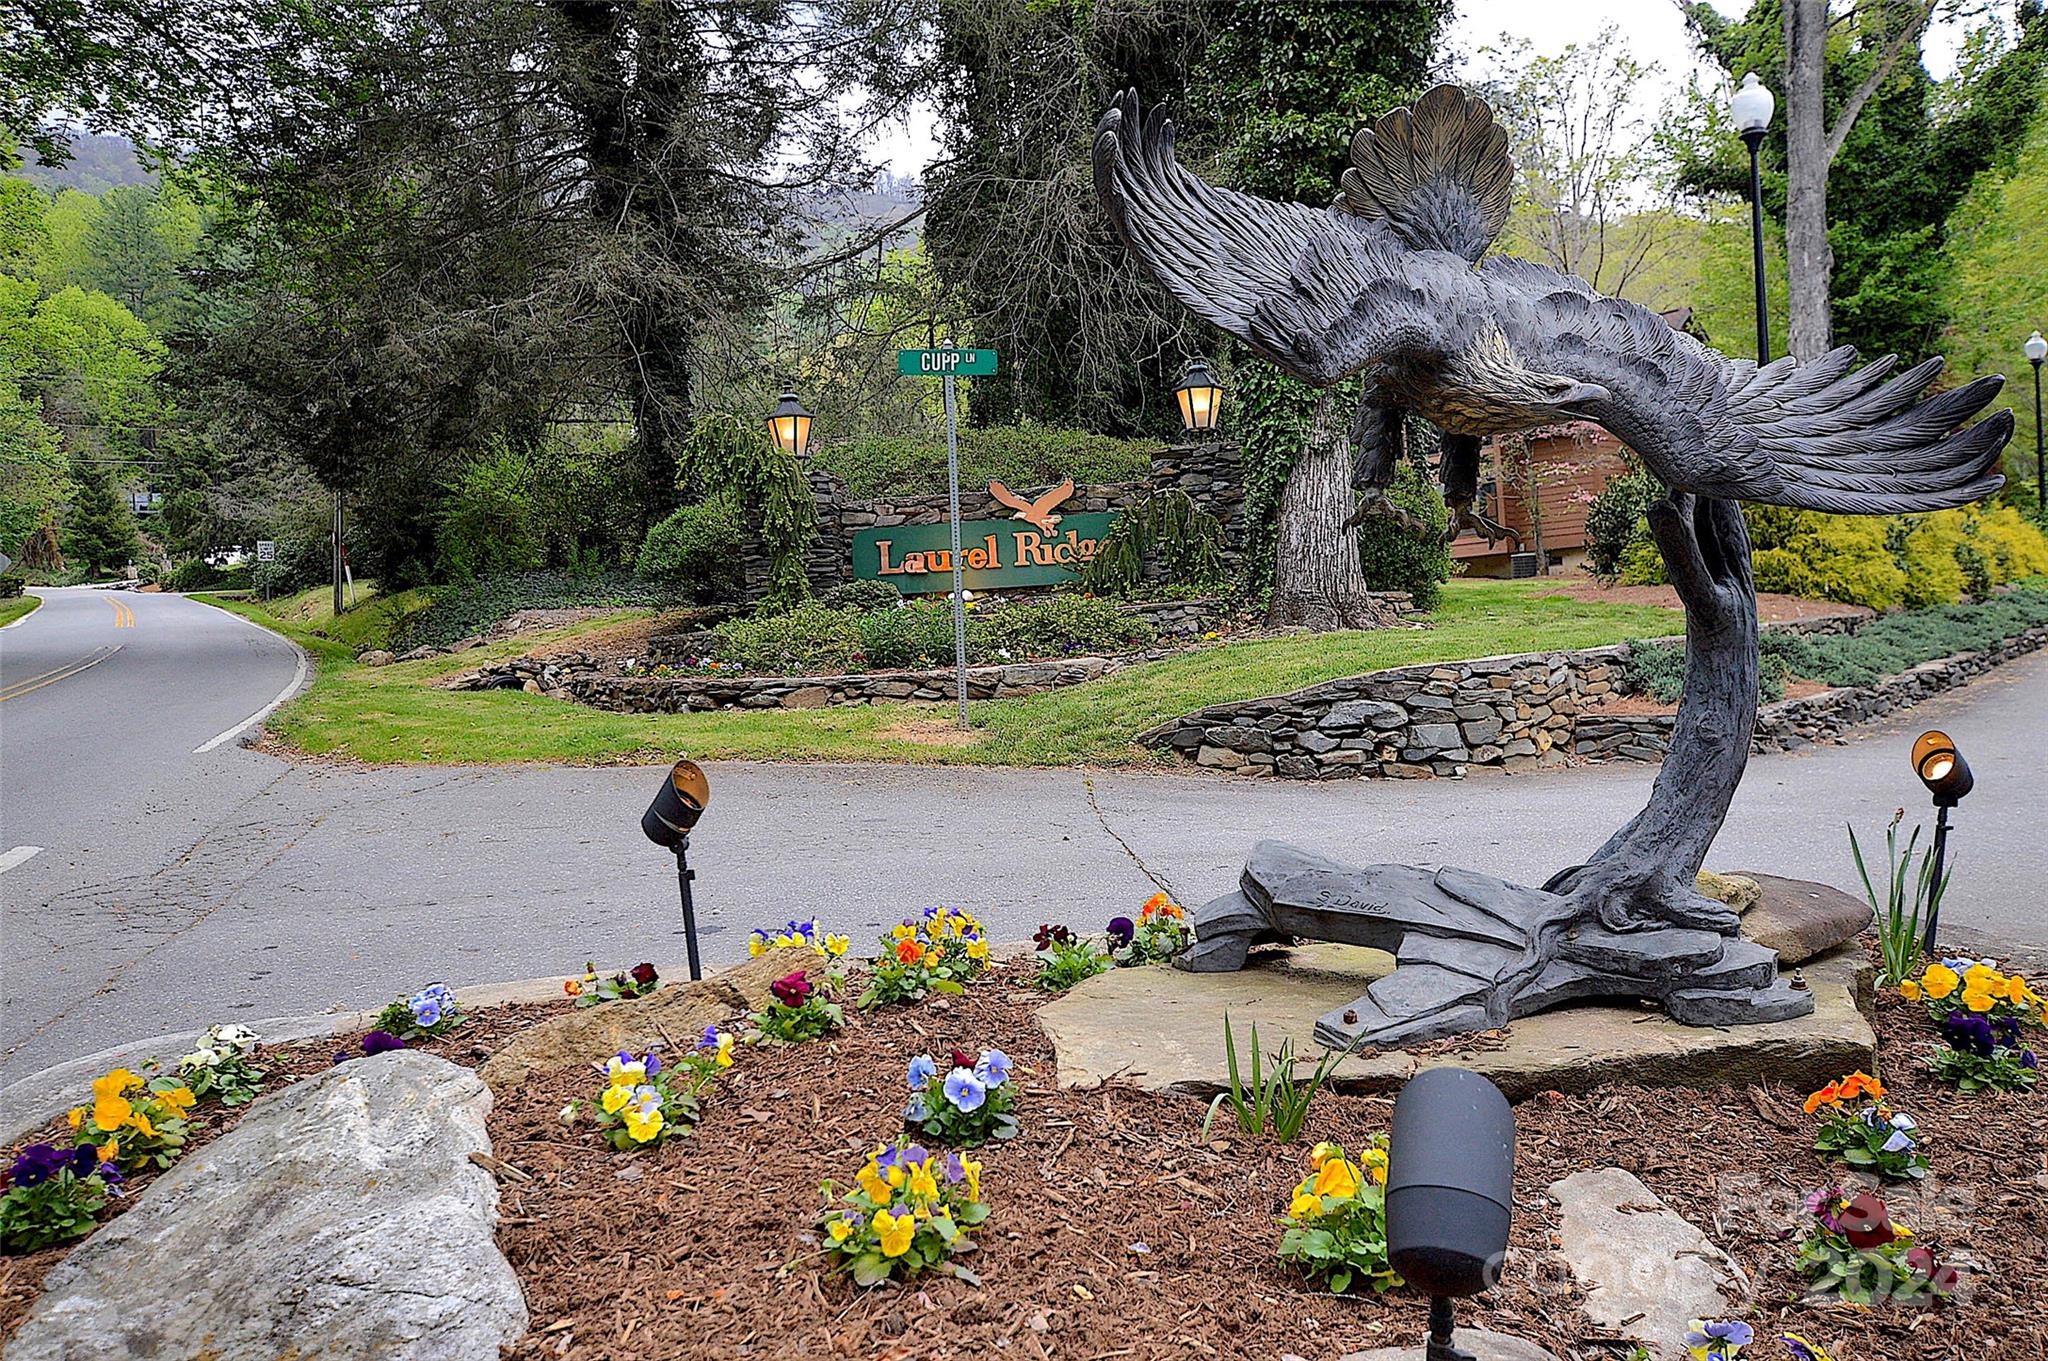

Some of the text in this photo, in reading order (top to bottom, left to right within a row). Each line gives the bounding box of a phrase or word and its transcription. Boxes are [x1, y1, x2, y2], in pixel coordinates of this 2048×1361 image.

[921, 352, 976, 371] CUPP LN
[260, 550, 273, 561] 25
[876, 534, 1002, 575] Laurel
